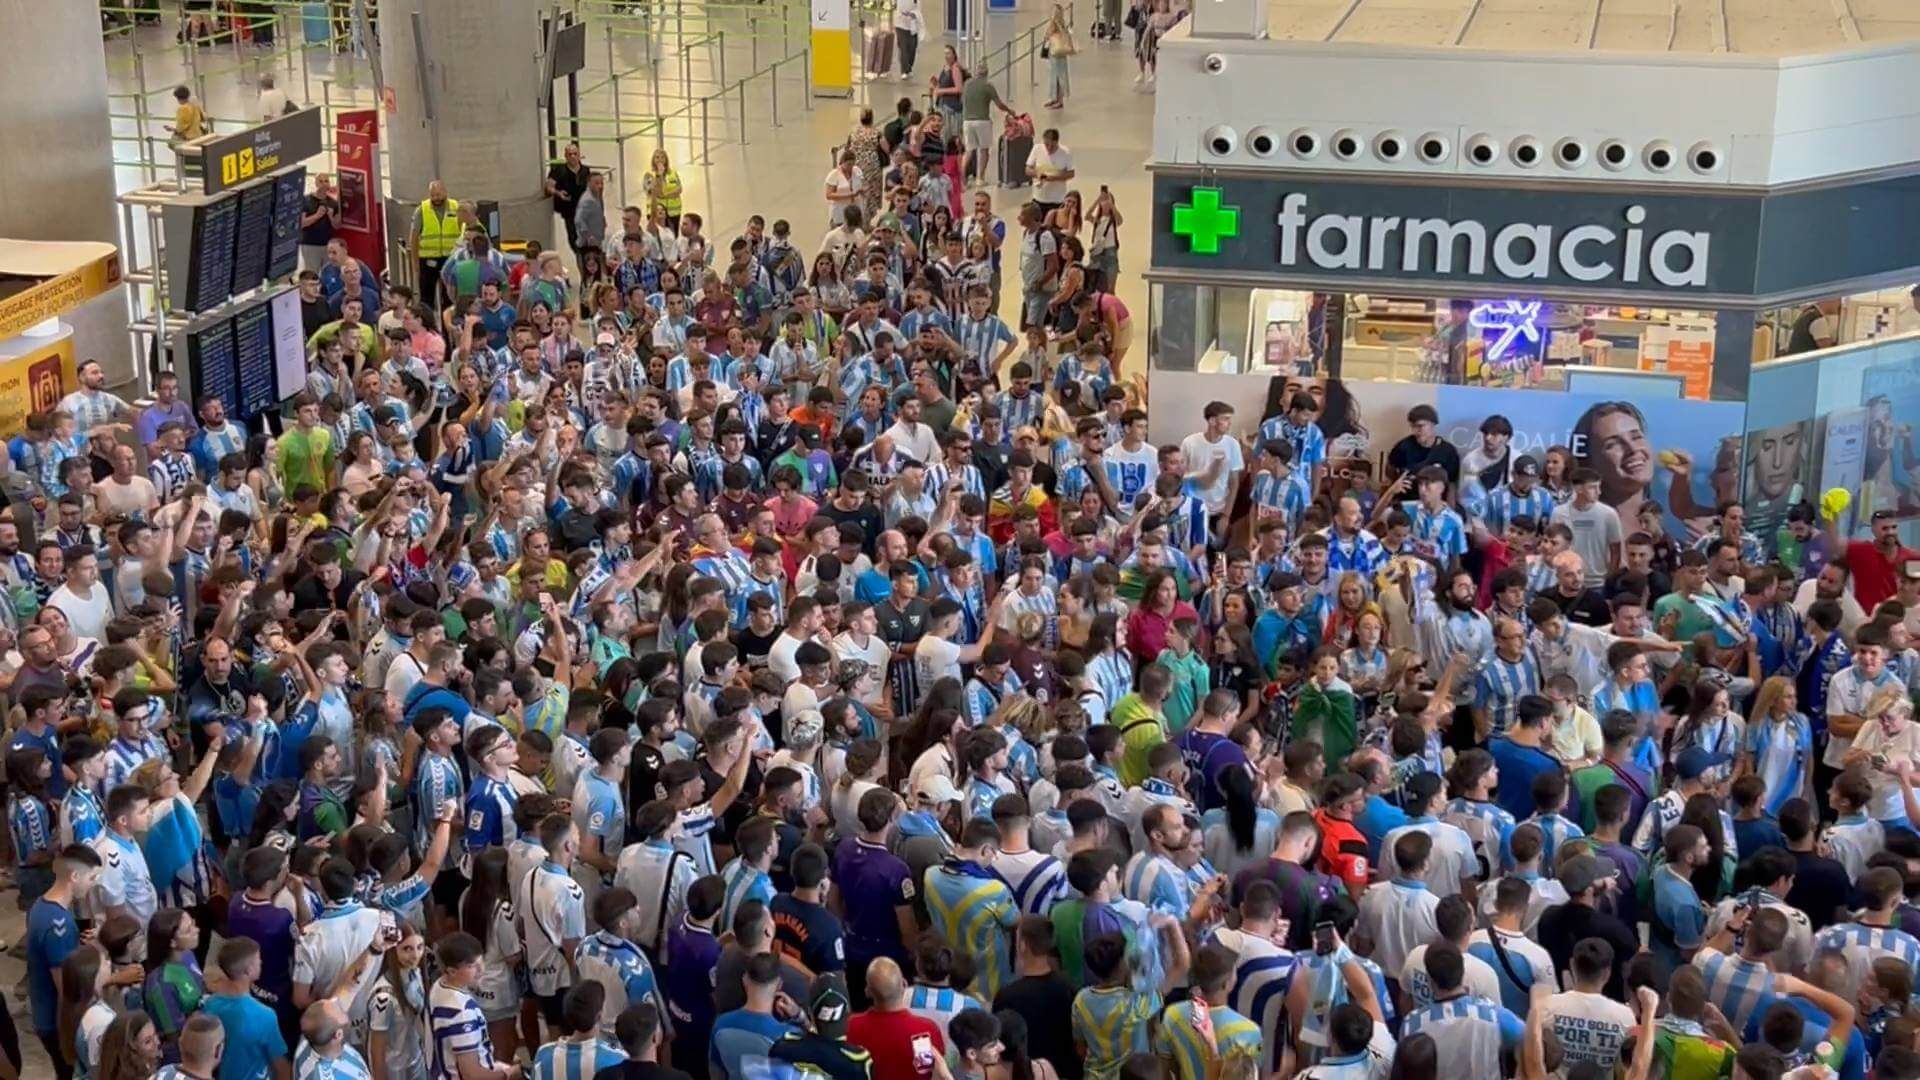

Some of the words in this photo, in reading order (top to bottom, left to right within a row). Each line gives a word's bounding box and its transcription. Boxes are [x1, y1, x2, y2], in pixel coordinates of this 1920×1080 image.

[1277, 192, 1711, 287] farmacia
[1554, 1014, 1585, 1028] VIVO
[1588, 1019, 1619, 1033] SOLO
[1554, 1025, 1590, 1044] POR
